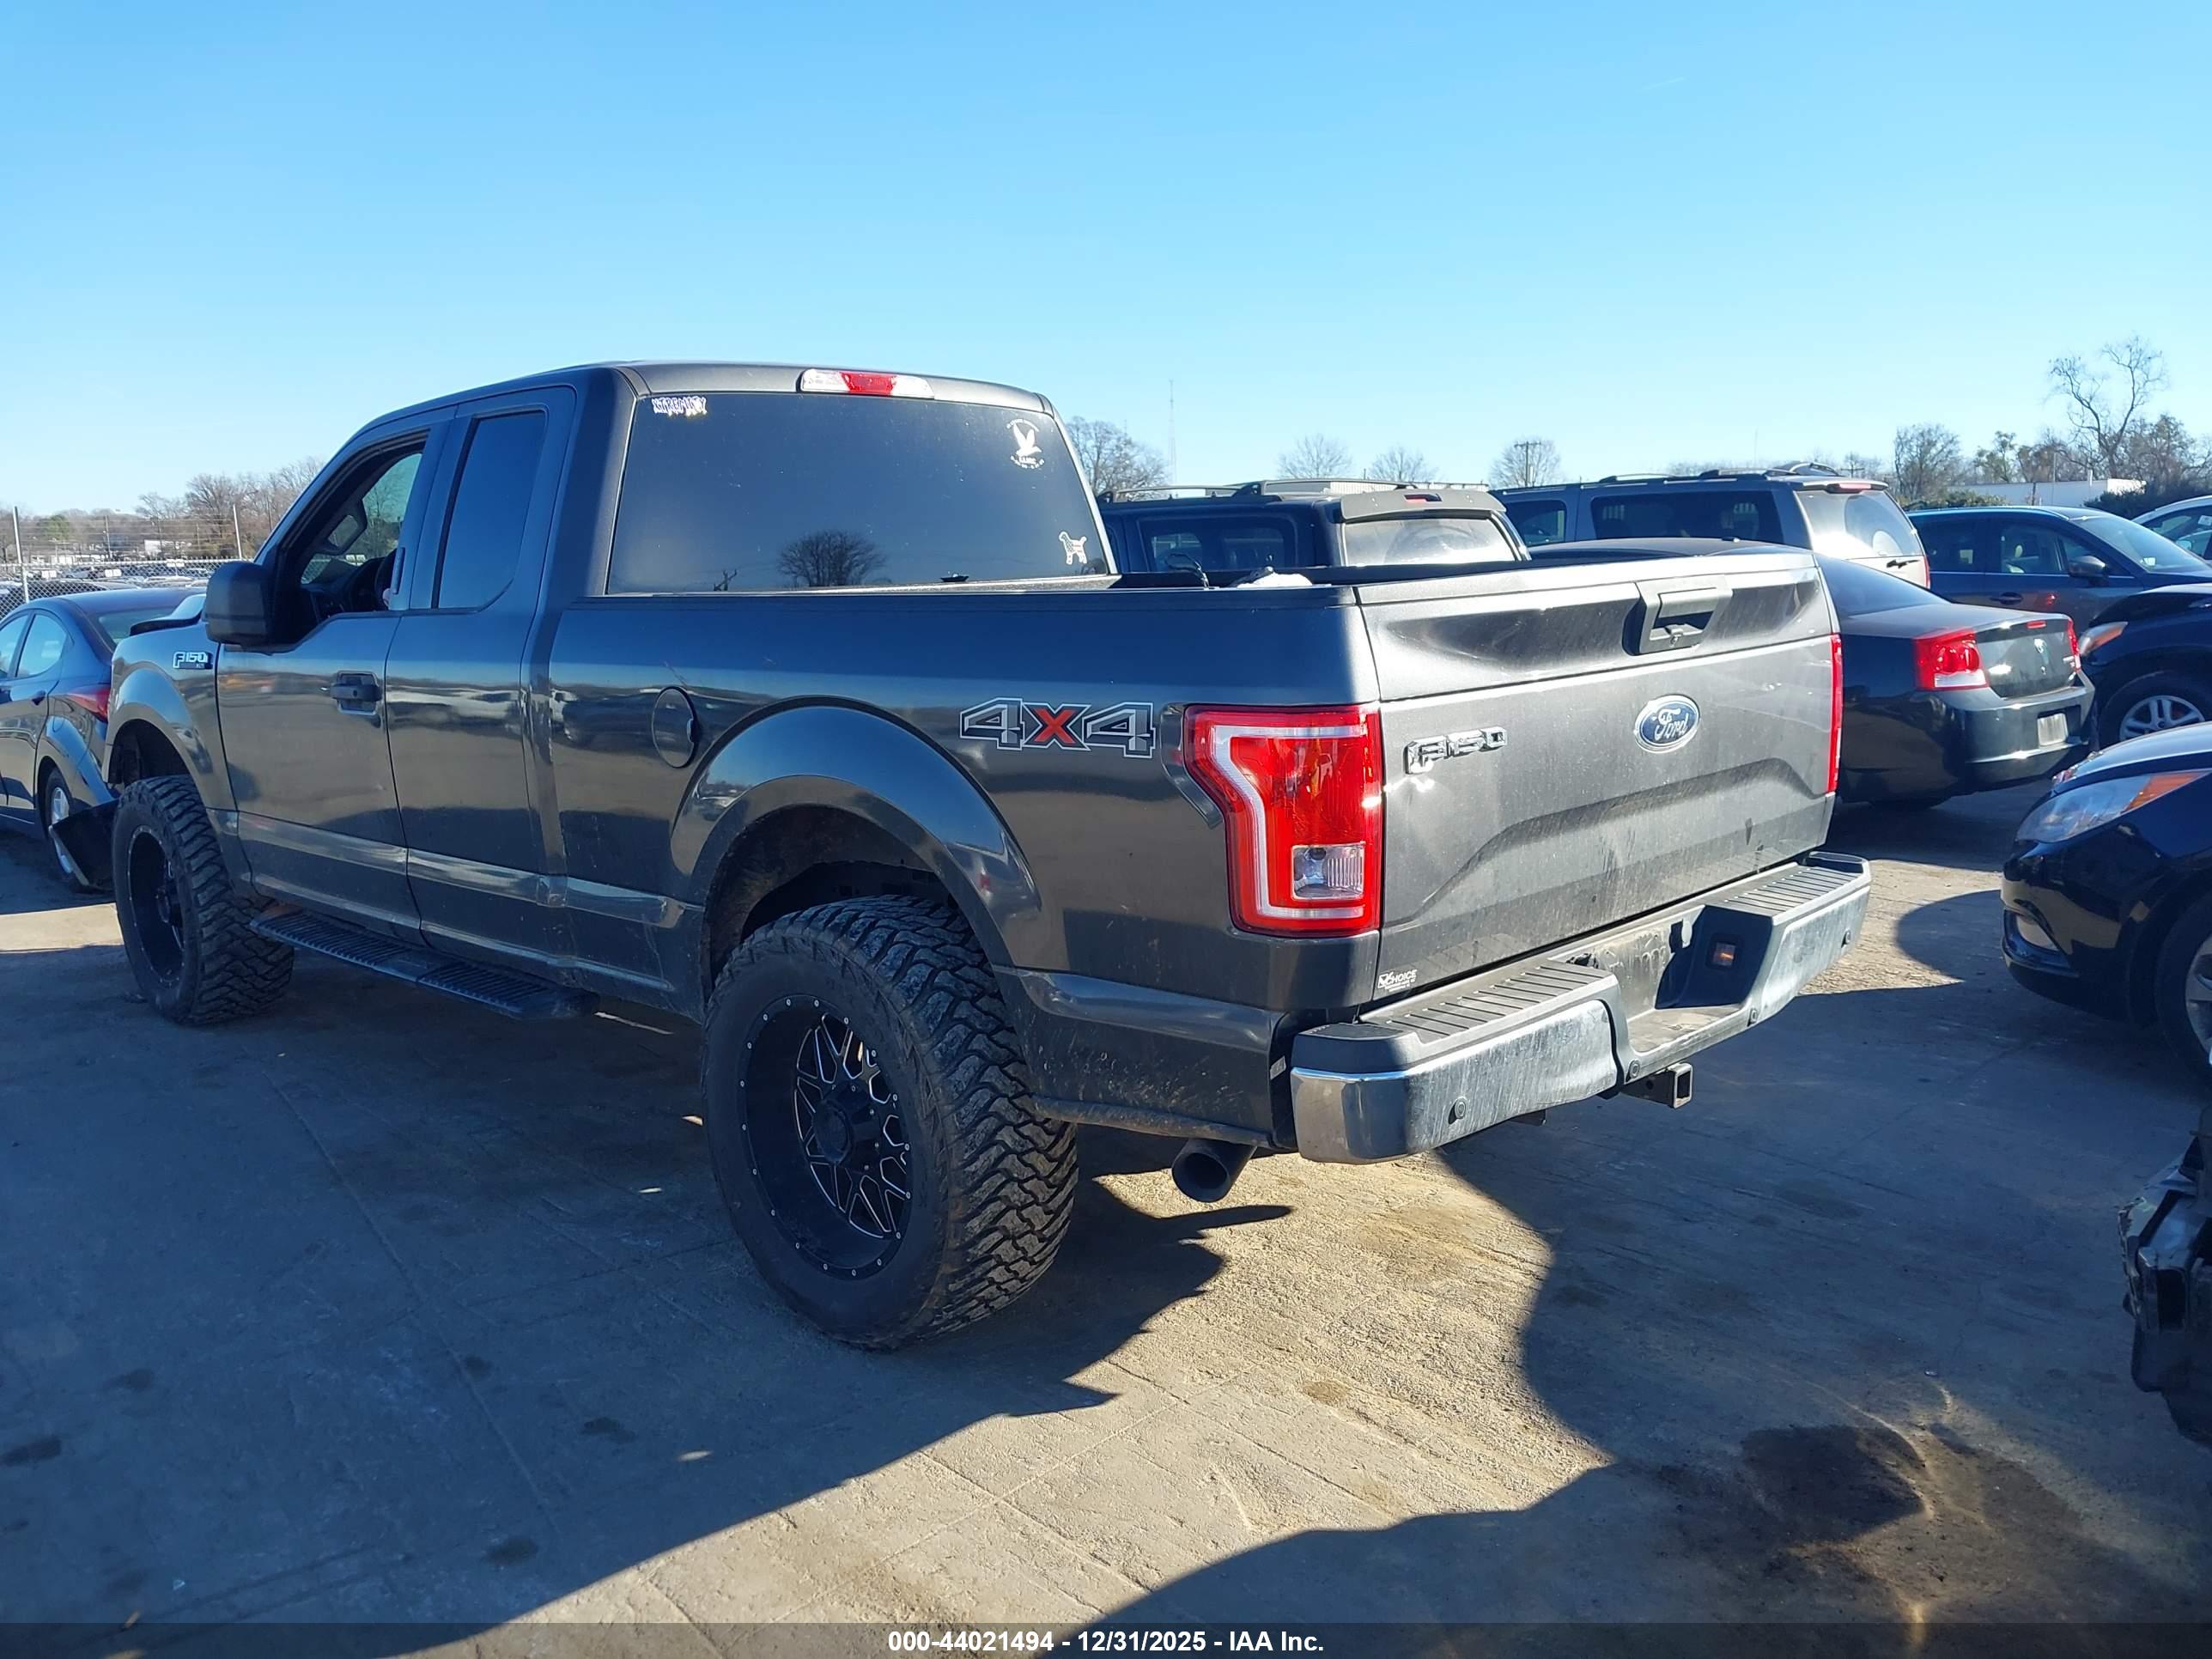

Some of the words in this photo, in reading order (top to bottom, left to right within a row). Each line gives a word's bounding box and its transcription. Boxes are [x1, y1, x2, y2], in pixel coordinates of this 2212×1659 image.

[173, 651, 209, 668] F150
[1651, 708, 1689, 741] Ford
[1402, 726, 1507, 775] F150
